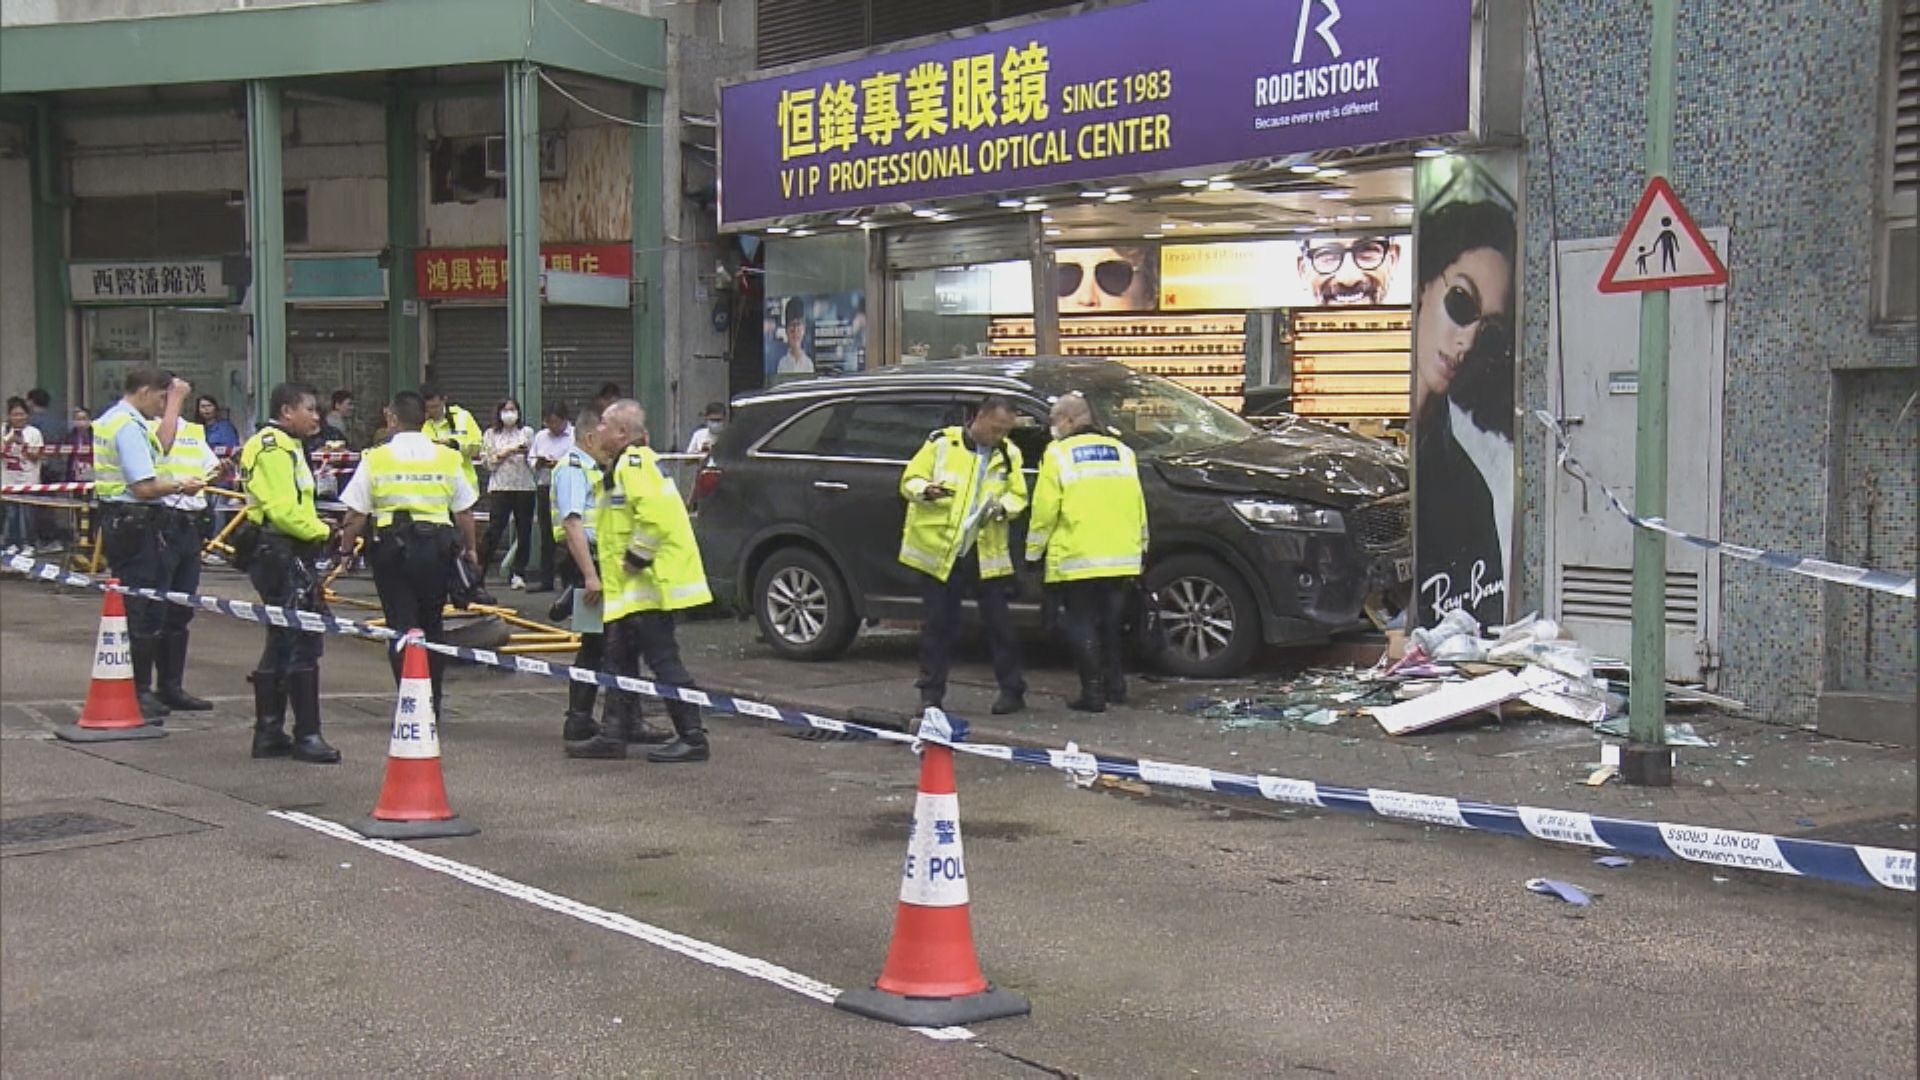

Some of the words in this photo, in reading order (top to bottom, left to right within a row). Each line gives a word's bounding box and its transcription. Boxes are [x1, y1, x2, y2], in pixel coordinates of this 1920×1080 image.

[778, 41, 1050, 161] 恒鋒專業眼鏡
[1062, 78, 1118, 113] SINCE
[1123, 69, 1171, 104] 1983
[1255, 57, 1379, 107] RODENSTOCK
[1255, 115, 1290, 129] Because
[1291, 111, 1314, 124] every
[1315, 108, 1330, 121] eye
[1331, 105, 1340, 117] is
[1341, 99, 1378, 116] different
[829, 143, 974, 193] PROFESSIONAL
[979, 129, 1072, 173] OPTICAL
[1077, 114, 1170, 160] CENTER
[1667, 828, 1708, 844] CROSS
